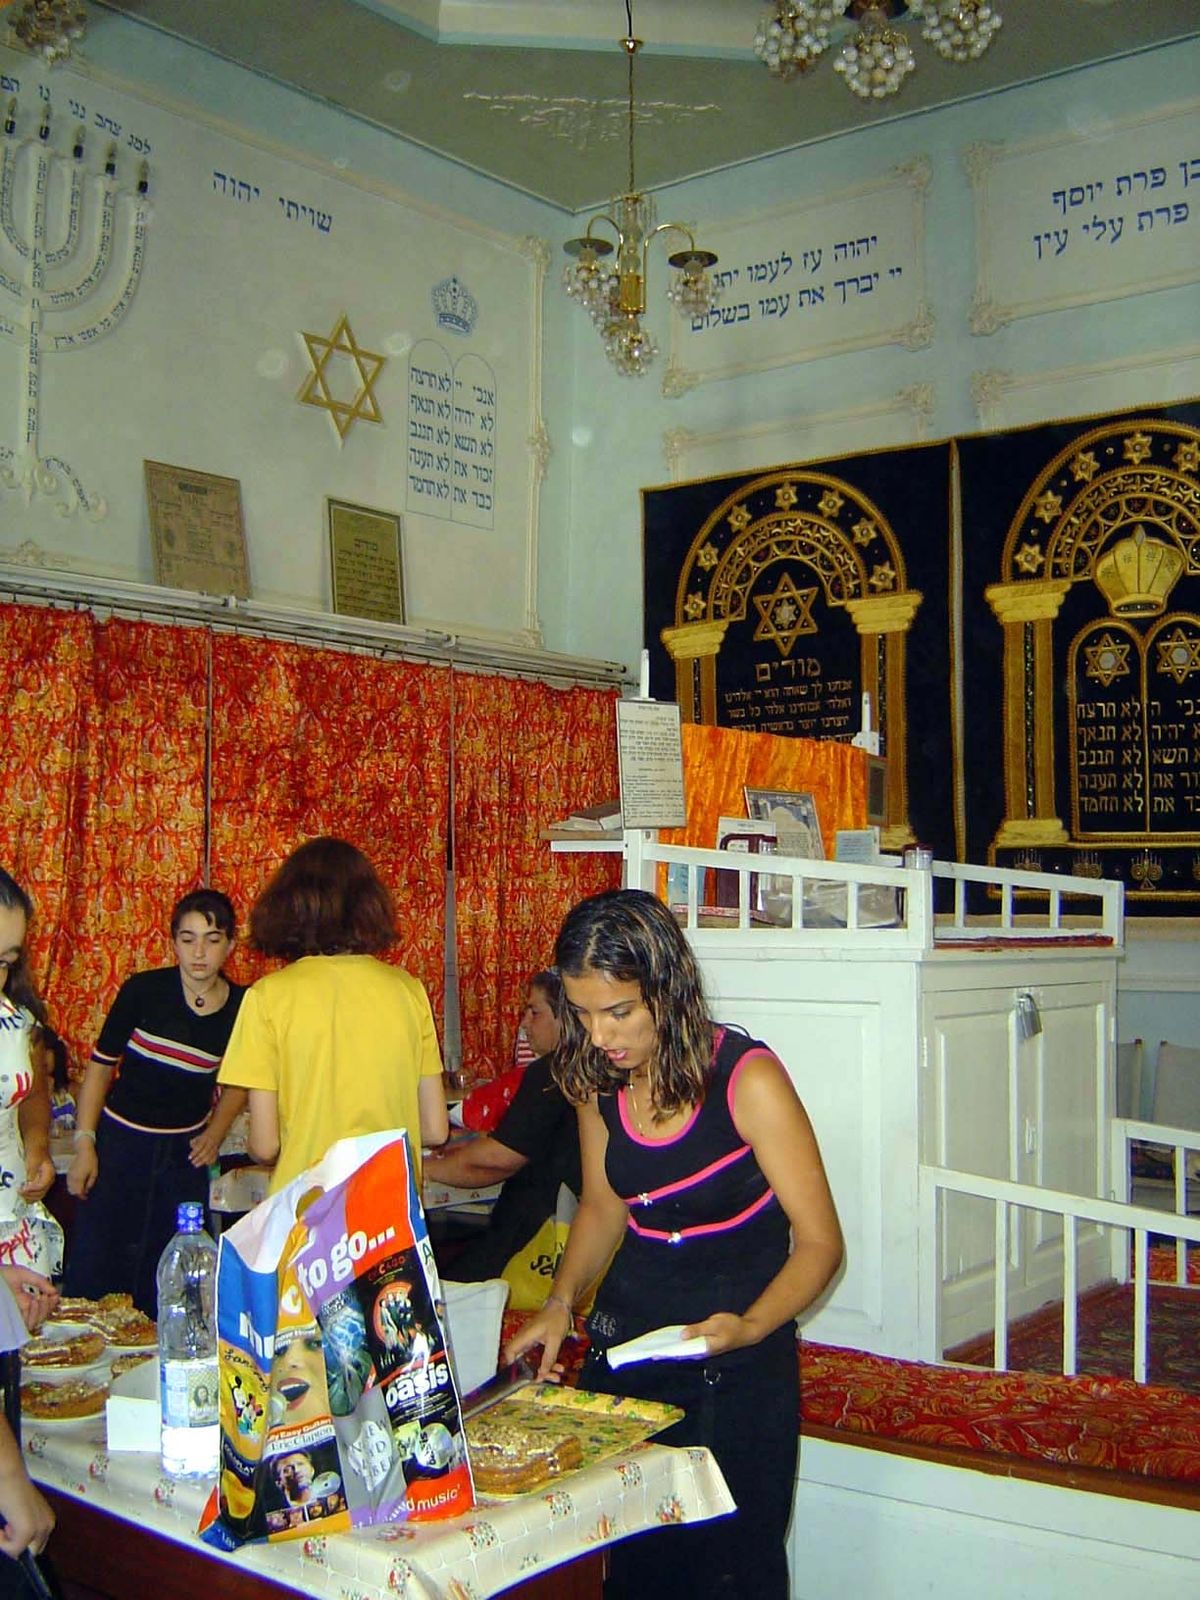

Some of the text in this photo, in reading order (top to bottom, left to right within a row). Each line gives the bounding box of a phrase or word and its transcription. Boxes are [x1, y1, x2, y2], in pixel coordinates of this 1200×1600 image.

[1116, 167, 1167, 196] פרת
[213, 170, 333, 233] שויתי יהוה
[1052, 182, 1104, 215] יוסף
[1033, 202, 1190, 260] פרת עלי עין
[834, 235, 878, 262] יהוה
[747, 251, 793, 283] לעמו
[803, 249, 823, 274] עז
[798, 285, 825, 308] את
[834, 272, 880, 305] יברך
[758, 293, 790, 318] עמו
[691, 303, 751, 332] בשלום
[437, 373, 451, 393] לא
[472, 386, 494, 406] אנכי
[437, 400, 451, 420] לא
[454, 407, 494, 432] לא יהיה
[437, 426, 450, 446] לא
[480, 438, 494, 458] לא
[436, 453, 450, 472] לא
[454, 460, 468, 478] את
[436, 479, 450, 499] לא
[453, 487, 467, 504] את
[755, 657, 821, 682] מודים
[1077, 694, 1140, 719] לא תרצח
[1122, 720, 1141, 741] לא
[1122, 743, 1141, 765] לא
[1152, 747, 1188, 765] תשא
[1122, 767, 1143, 788] לא
[1153, 773, 1174, 789] את
[1080, 789, 1144, 813] לא תחמד
[1153, 796, 1175, 813] את
[298, 1258, 327, 1298] to
[330, 1226, 396, 1282] go...
[386, 1363, 449, 1408] oasis
